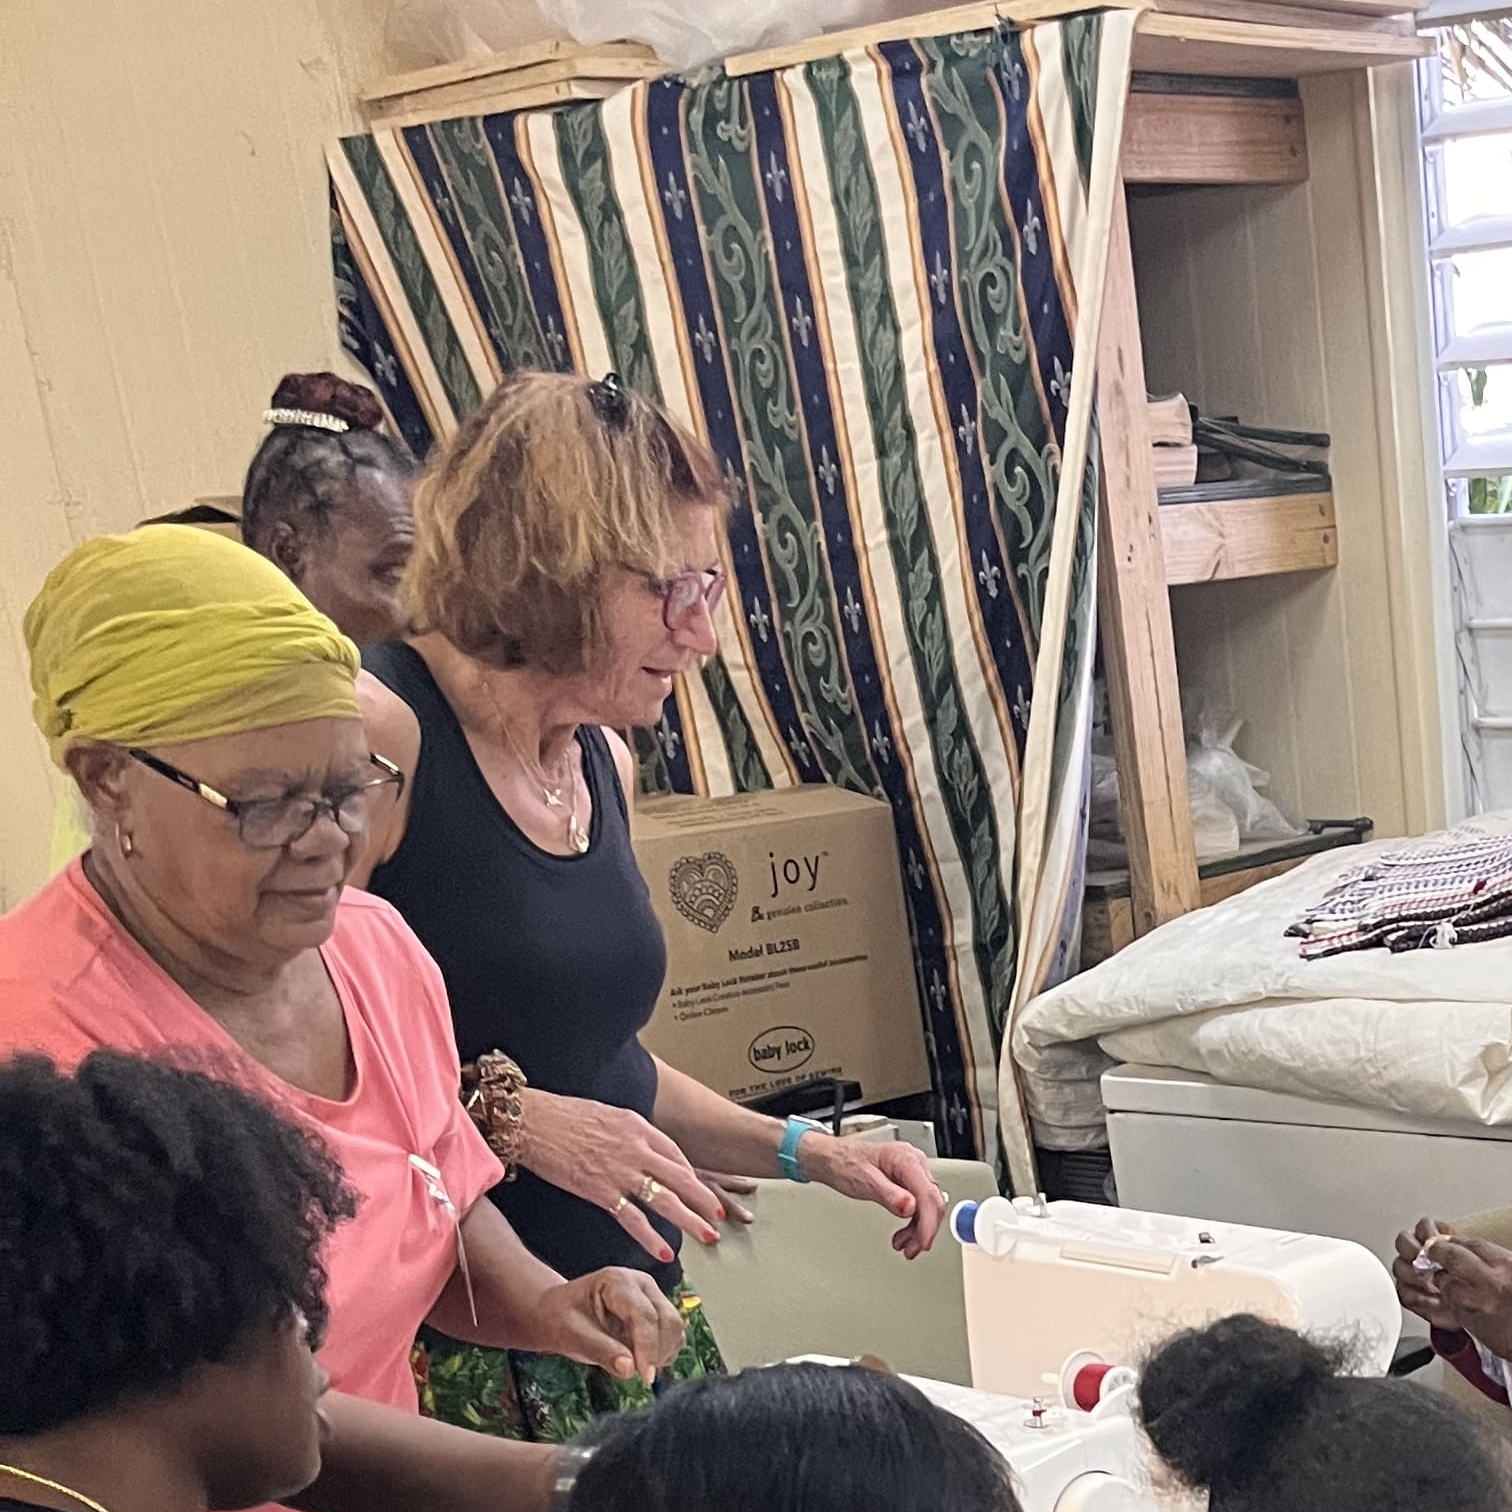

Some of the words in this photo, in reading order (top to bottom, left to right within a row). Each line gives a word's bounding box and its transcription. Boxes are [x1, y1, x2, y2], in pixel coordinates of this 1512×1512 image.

[768, 851, 819, 898] joy
[728, 944, 763, 962] Model
[753, 1044, 781, 1062] baby
[785, 1036, 811, 1056] lock
